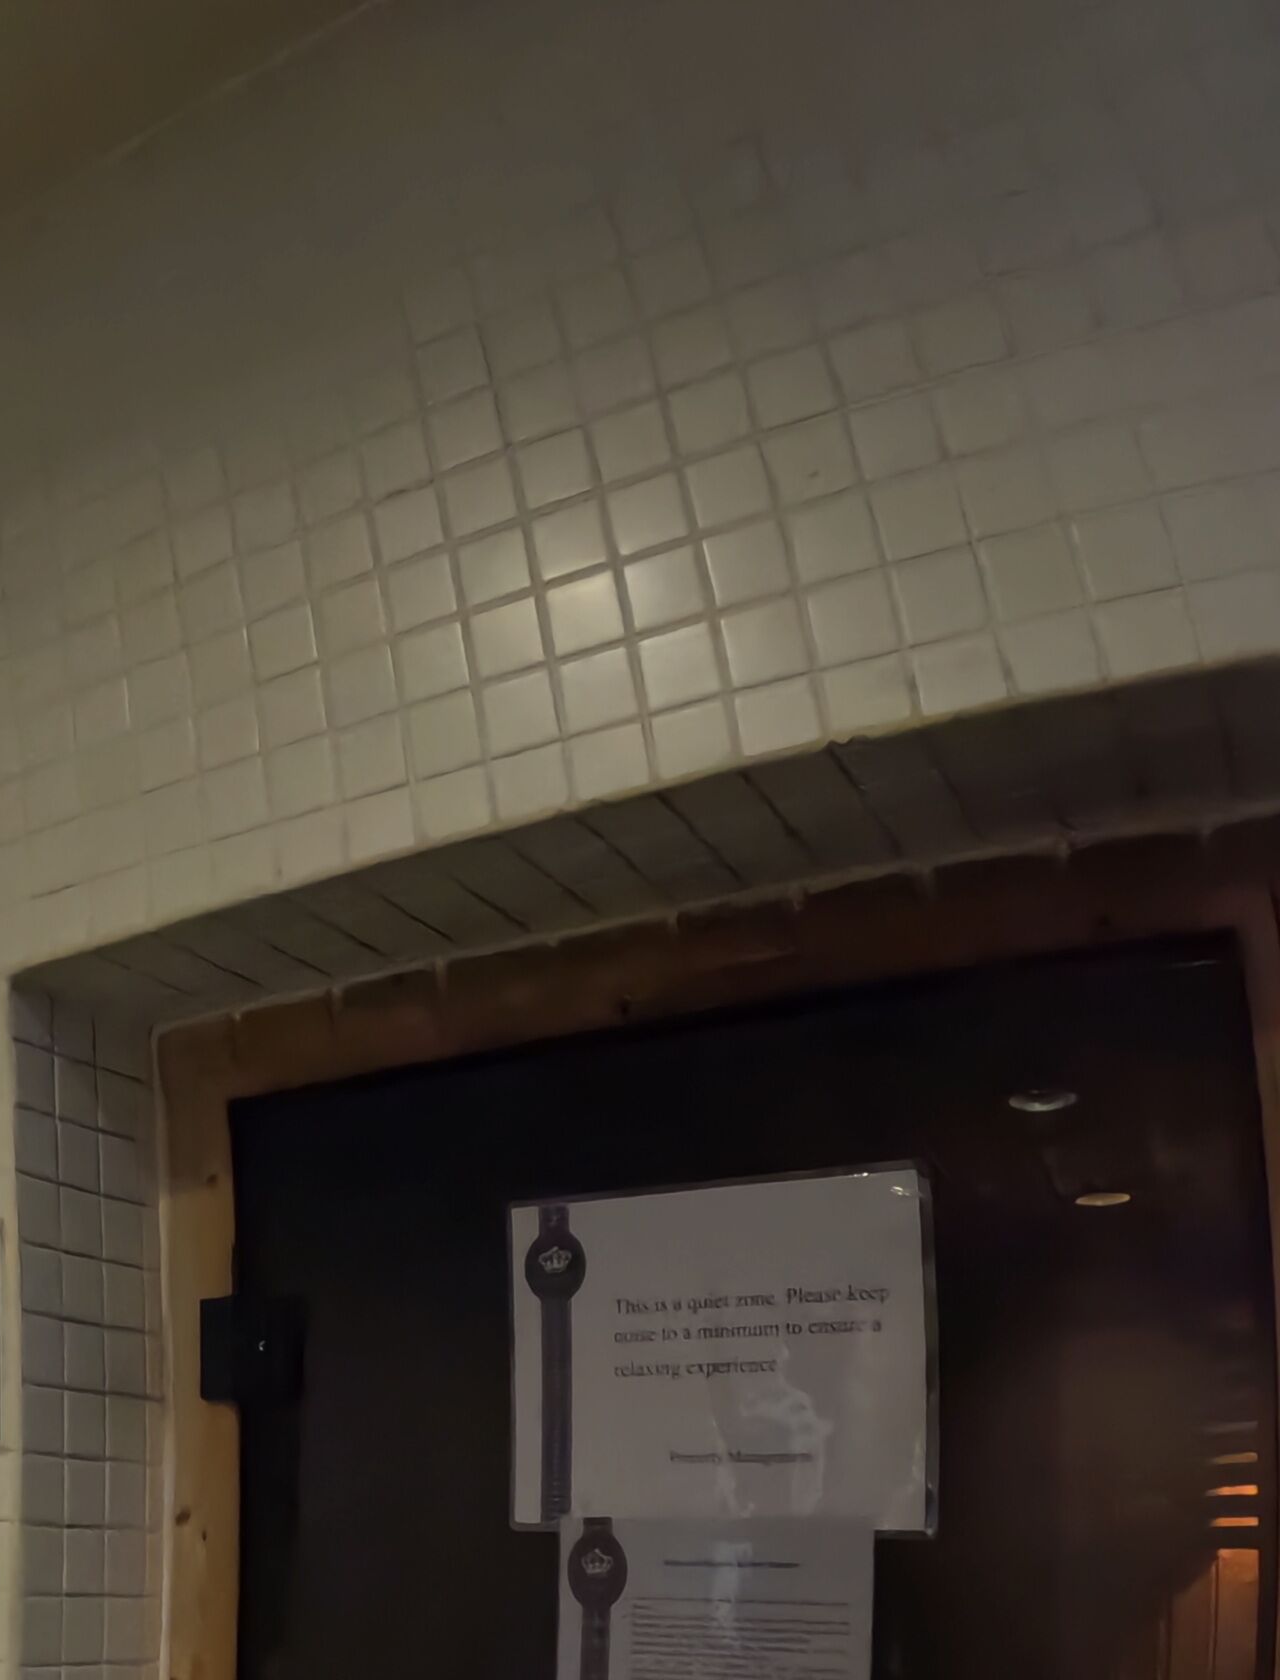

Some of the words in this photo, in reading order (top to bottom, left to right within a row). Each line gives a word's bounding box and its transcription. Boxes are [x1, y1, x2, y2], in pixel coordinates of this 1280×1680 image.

[615, 1297, 649, 1315] This
[654, 1298, 669, 1313] is
[687, 1292, 730, 1315] quiet
[786, 1286, 842, 1305] Please
[847, 1283, 890, 1305] keep
[696, 1322, 780, 1340] minimum
[785, 1320, 803, 1335] to
[614, 1359, 682, 1380] relaxing
